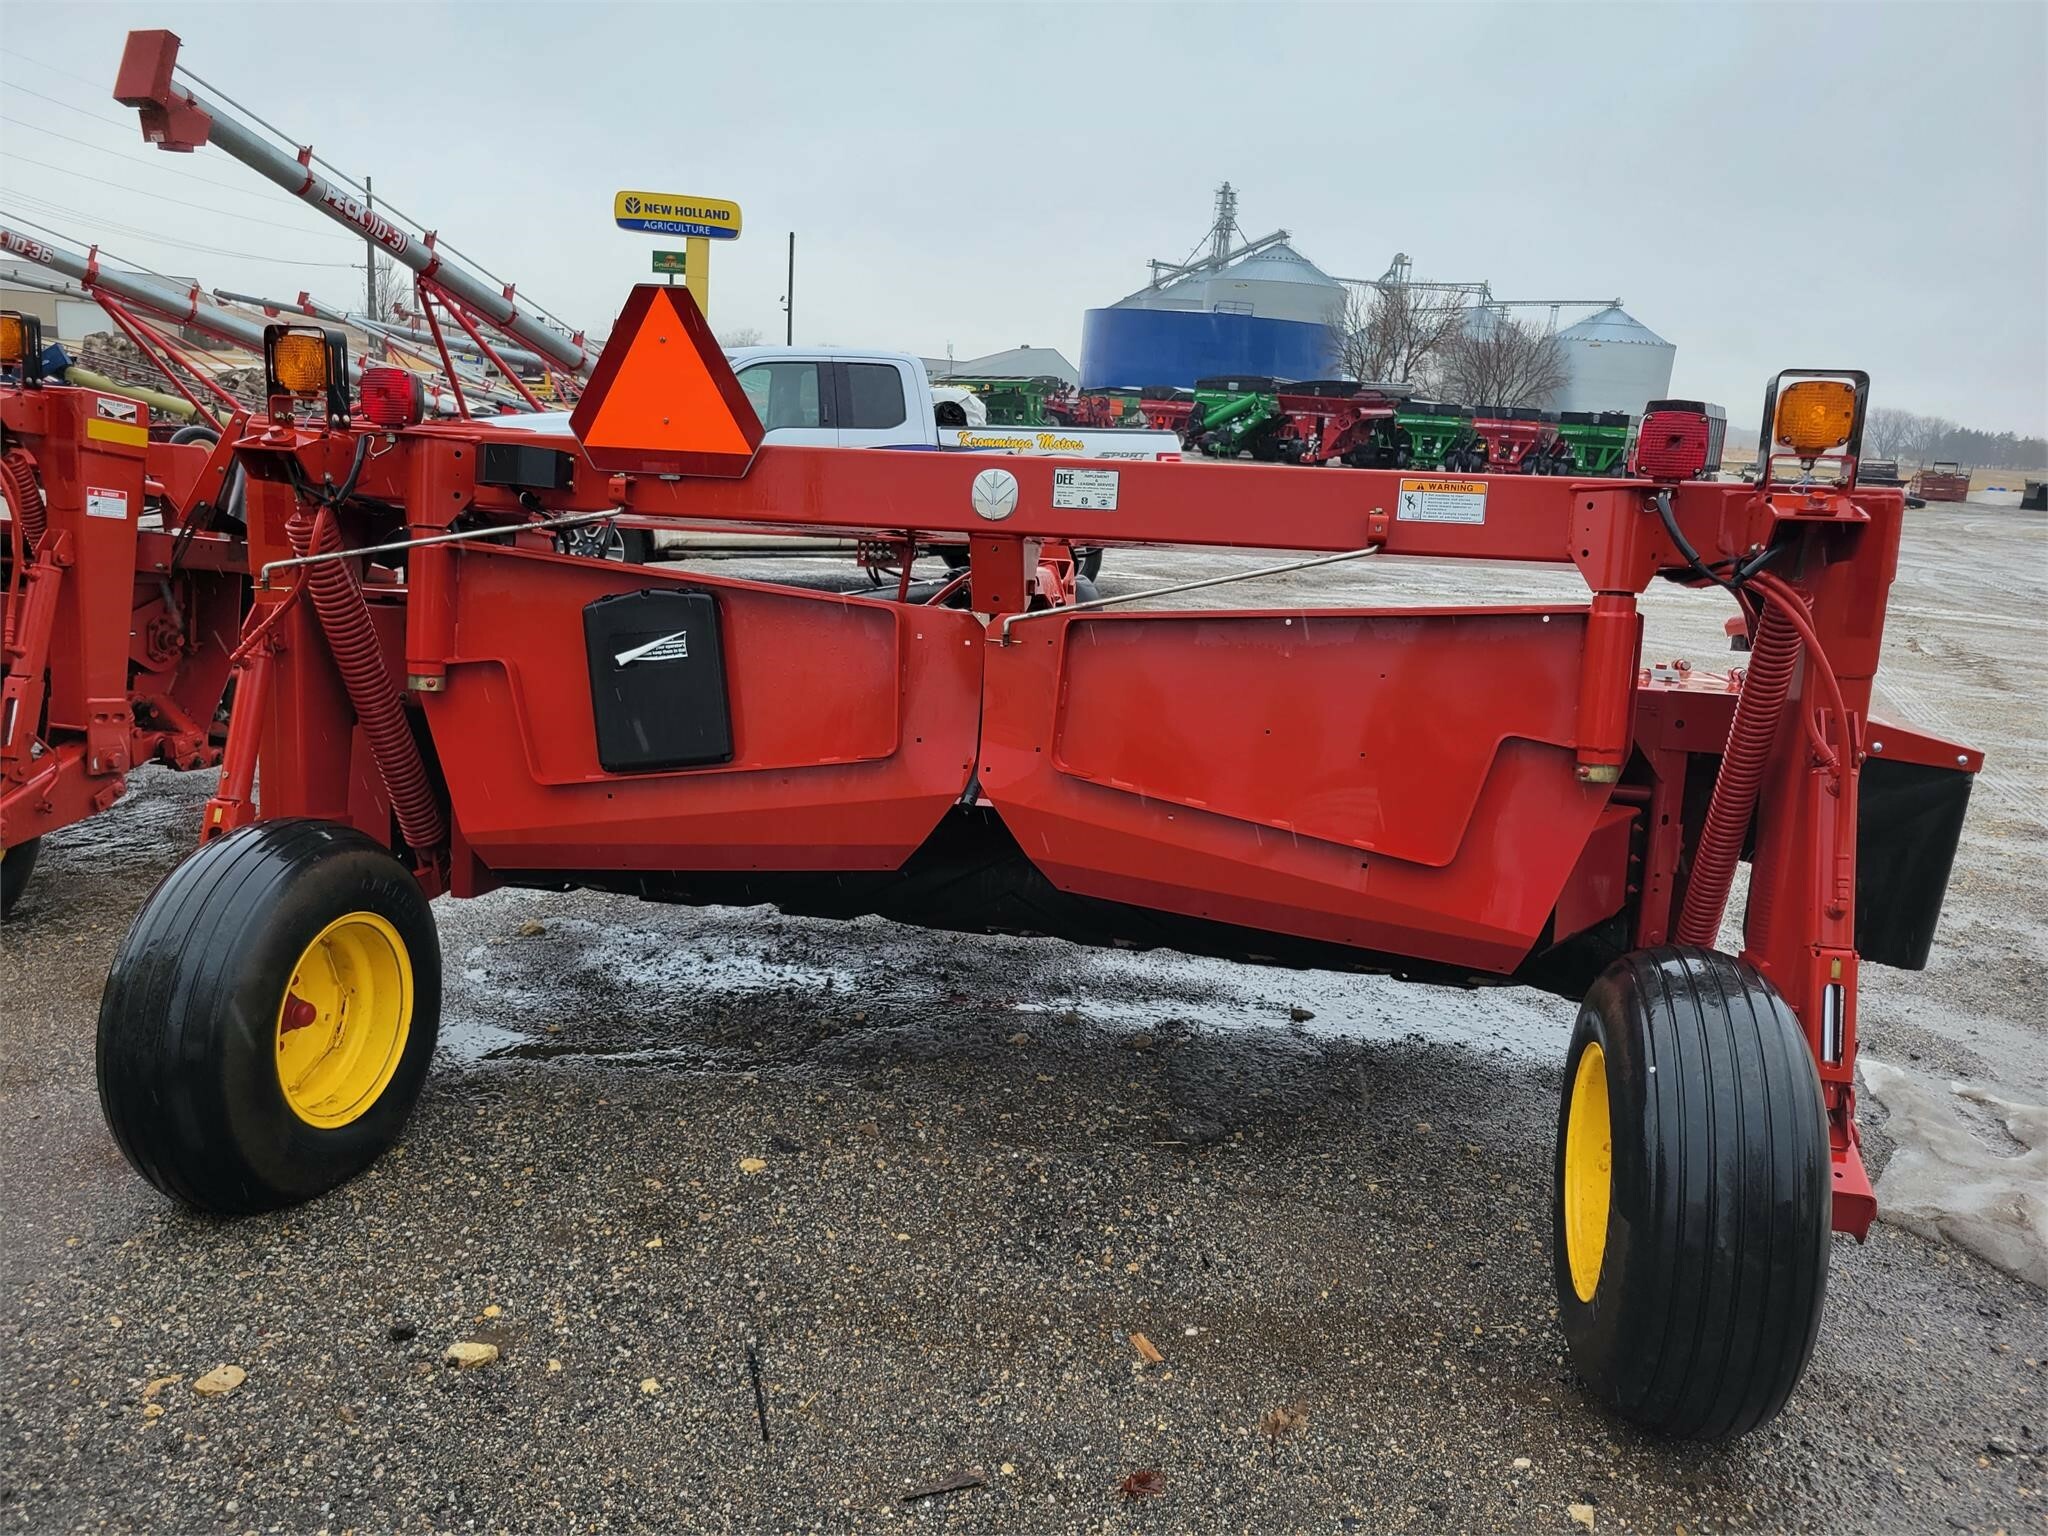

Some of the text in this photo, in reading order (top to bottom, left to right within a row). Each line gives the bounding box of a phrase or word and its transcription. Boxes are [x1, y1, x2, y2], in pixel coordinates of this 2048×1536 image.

[323, 186, 369, 226] PECK
[644, 203, 730, 221] NEW HOLLAND
[643, 221, 711, 235] AGRICULTURE
[957, 431, 1085, 454] Kromminga Motors
[1101, 451, 1150, 459] SPORT
[1056, 473, 1075, 485] DEE
[1428, 483, 1474, 492] WARNING
